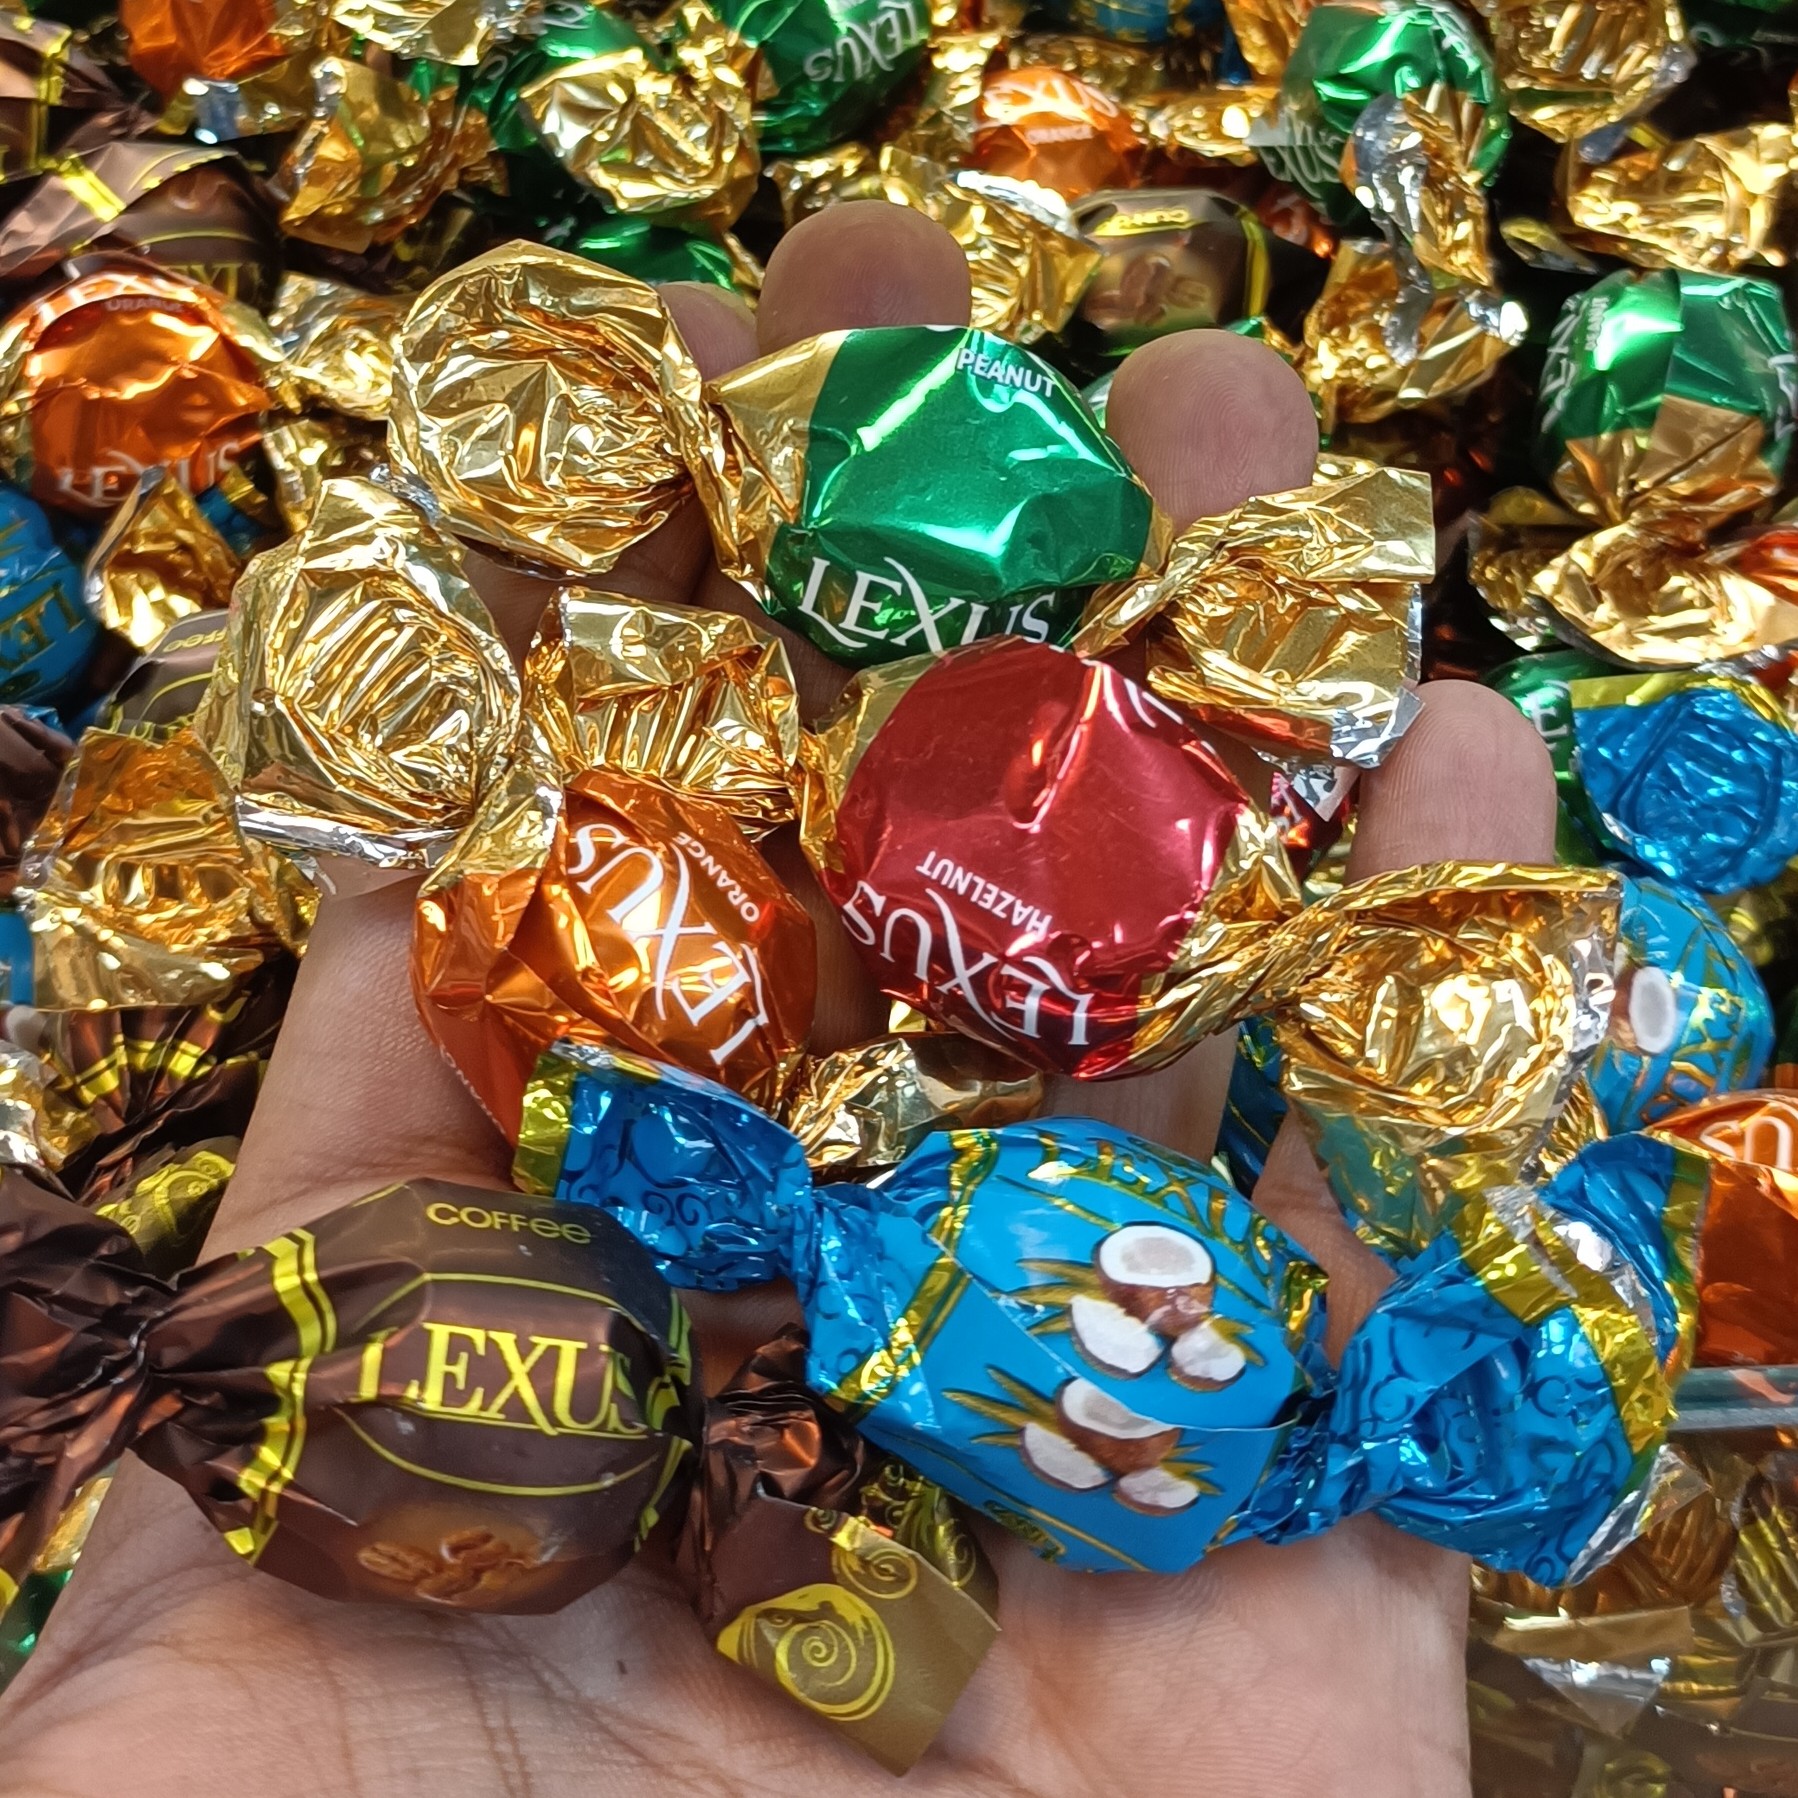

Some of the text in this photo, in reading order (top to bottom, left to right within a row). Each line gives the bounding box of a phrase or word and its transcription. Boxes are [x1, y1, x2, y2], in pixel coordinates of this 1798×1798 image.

[956, 347, 1057, 398] PEANUT
[797, 555, 1057, 664] LEXUS
[673, 831, 760, 922] ORANGE
[915, 850, 1052, 942] HAZELNUT
[567, 823, 770, 1066] LEXUS
[841, 880, 1095, 1046] LEXUS
